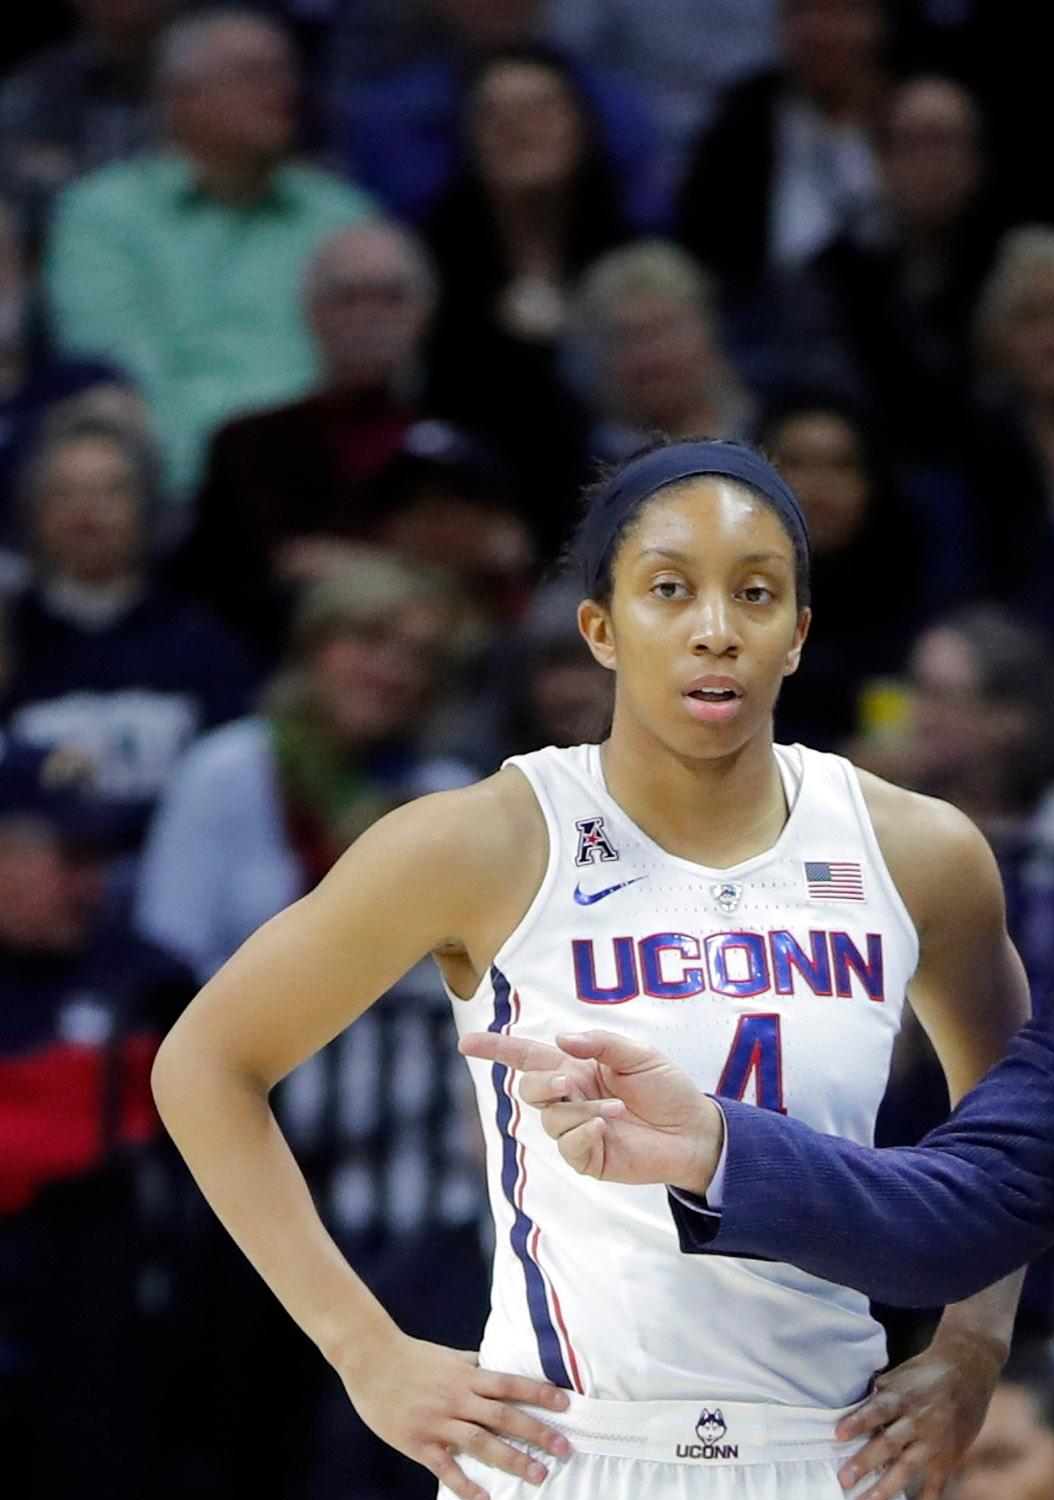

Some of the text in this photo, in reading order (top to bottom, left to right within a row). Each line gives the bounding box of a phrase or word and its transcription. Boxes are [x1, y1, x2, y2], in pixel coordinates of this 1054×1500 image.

[575, 816, 619, 867] A
[571, 930, 885, 1004] UCONN
[715, 1013, 787, 1116] 4
[676, 1444, 739, 1460] UCONN
